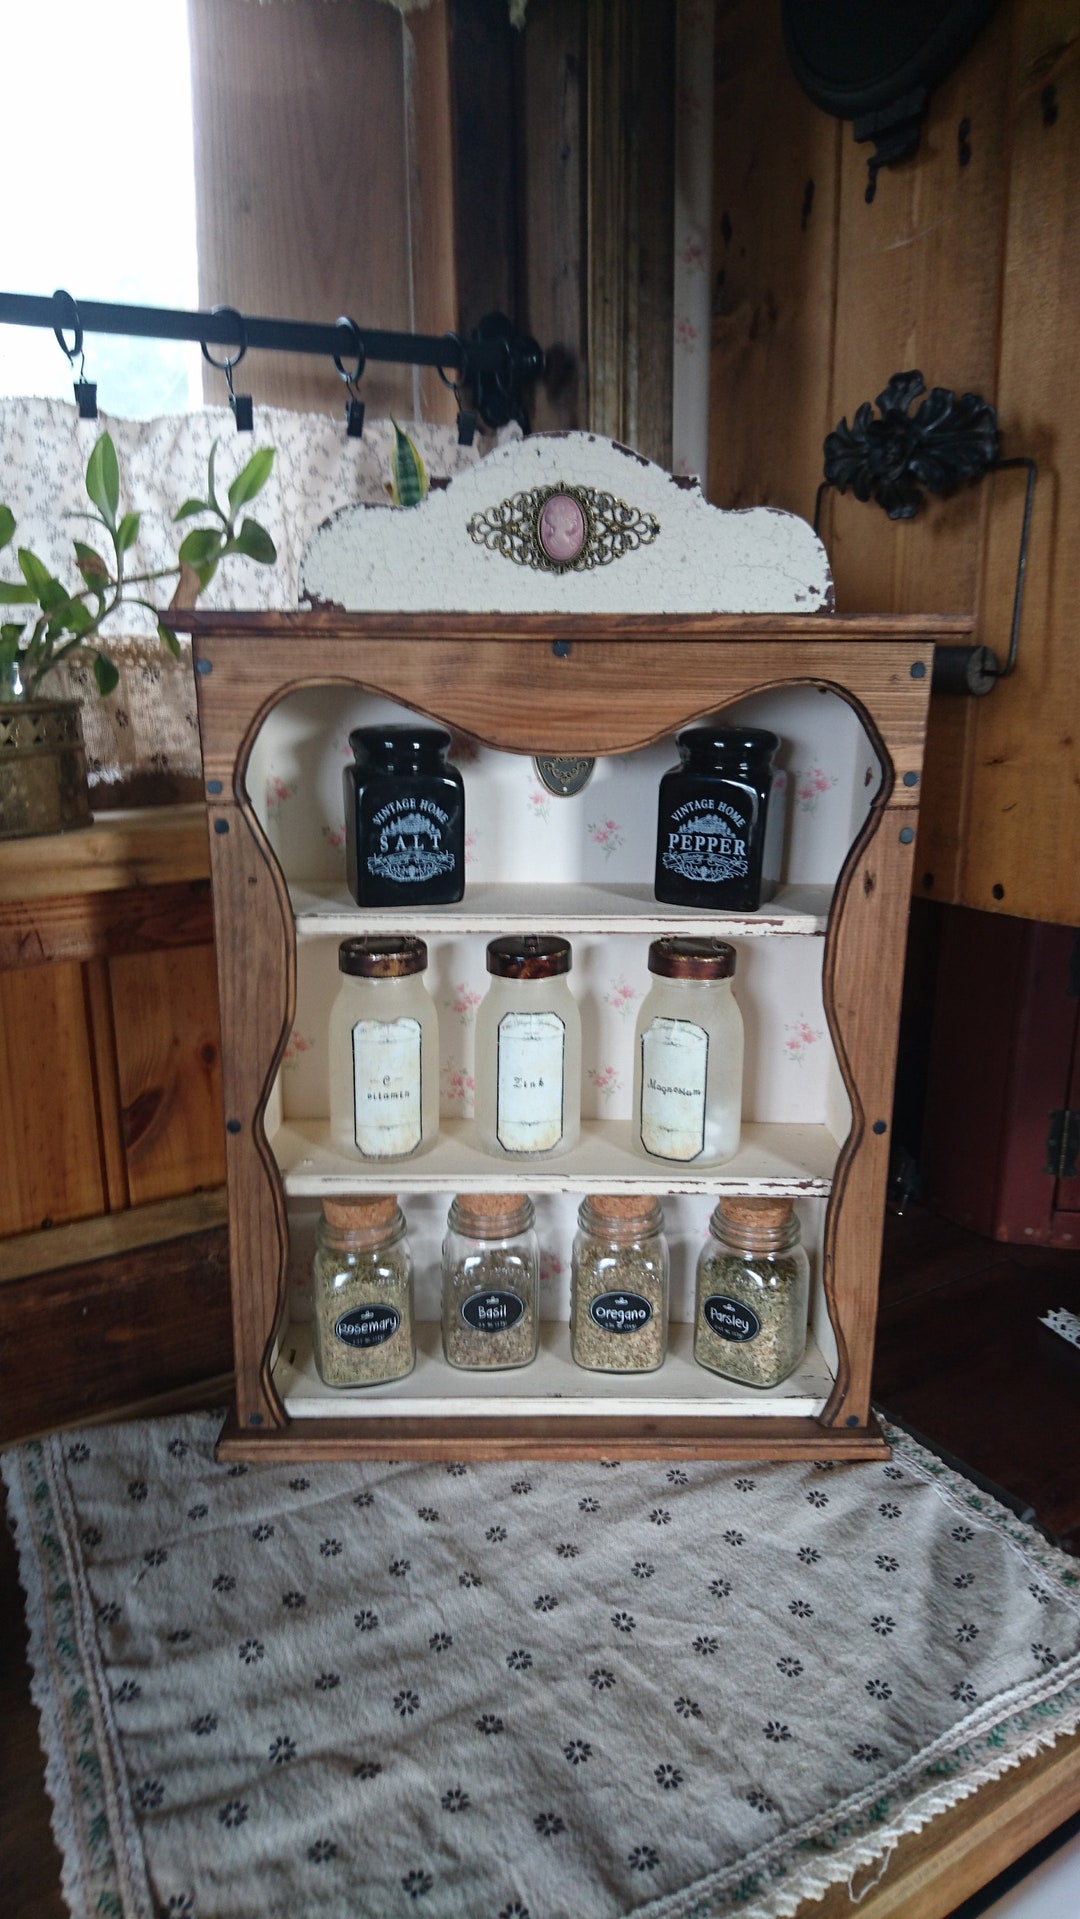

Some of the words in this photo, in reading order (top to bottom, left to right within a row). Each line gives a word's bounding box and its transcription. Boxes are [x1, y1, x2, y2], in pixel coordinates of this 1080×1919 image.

[372, 798, 417, 825] VINTAGE
[420, 799, 449, 824] HOME
[670, 799, 715, 822] VINTAGE
[717, 801, 746, 828] HOME
[380, 834, 441, 852] SALT
[668, 833, 746, 856] PEPPER
[478, 1304, 507, 1319] Basil
[595, 1306, 646, 1325] Oregano
[710, 1307, 749, 1334] Parsley
[338, 1316, 397, 1336] Rosemary
